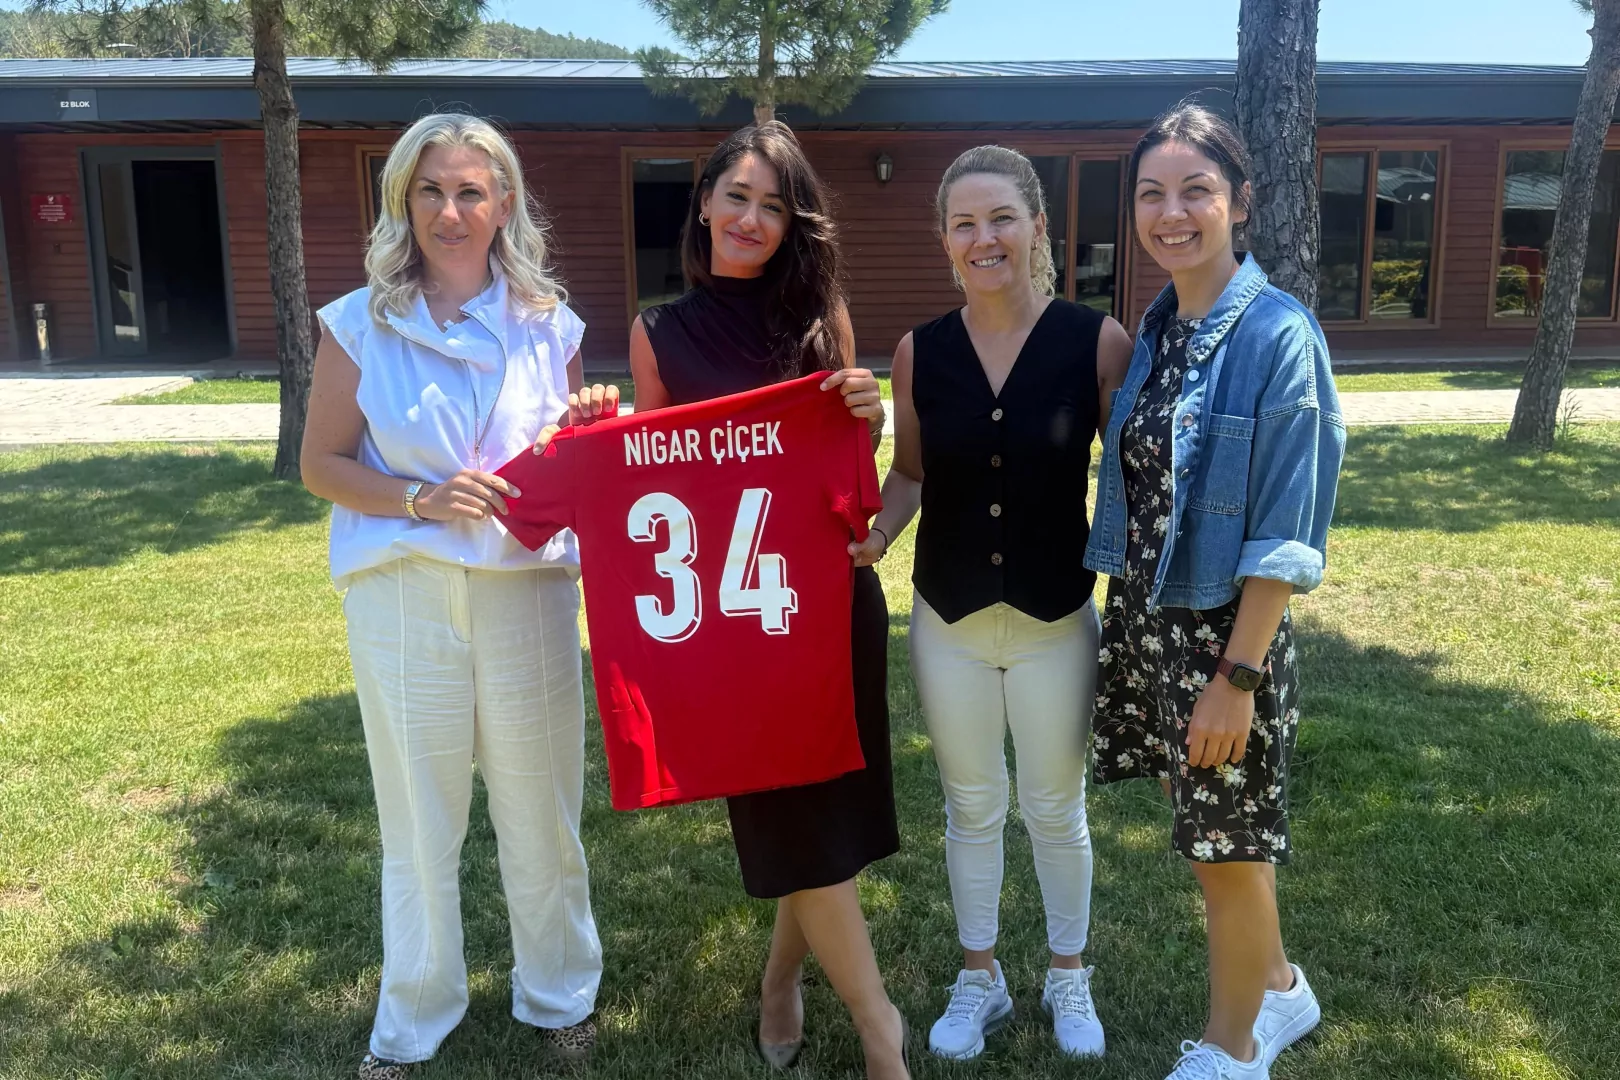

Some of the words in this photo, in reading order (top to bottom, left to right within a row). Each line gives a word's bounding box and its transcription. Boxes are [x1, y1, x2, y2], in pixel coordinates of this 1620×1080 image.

[623, 426, 703, 466] NİGAR
[709, 420, 784, 465] ÇİÇEK
[627, 487, 799, 643] 34
